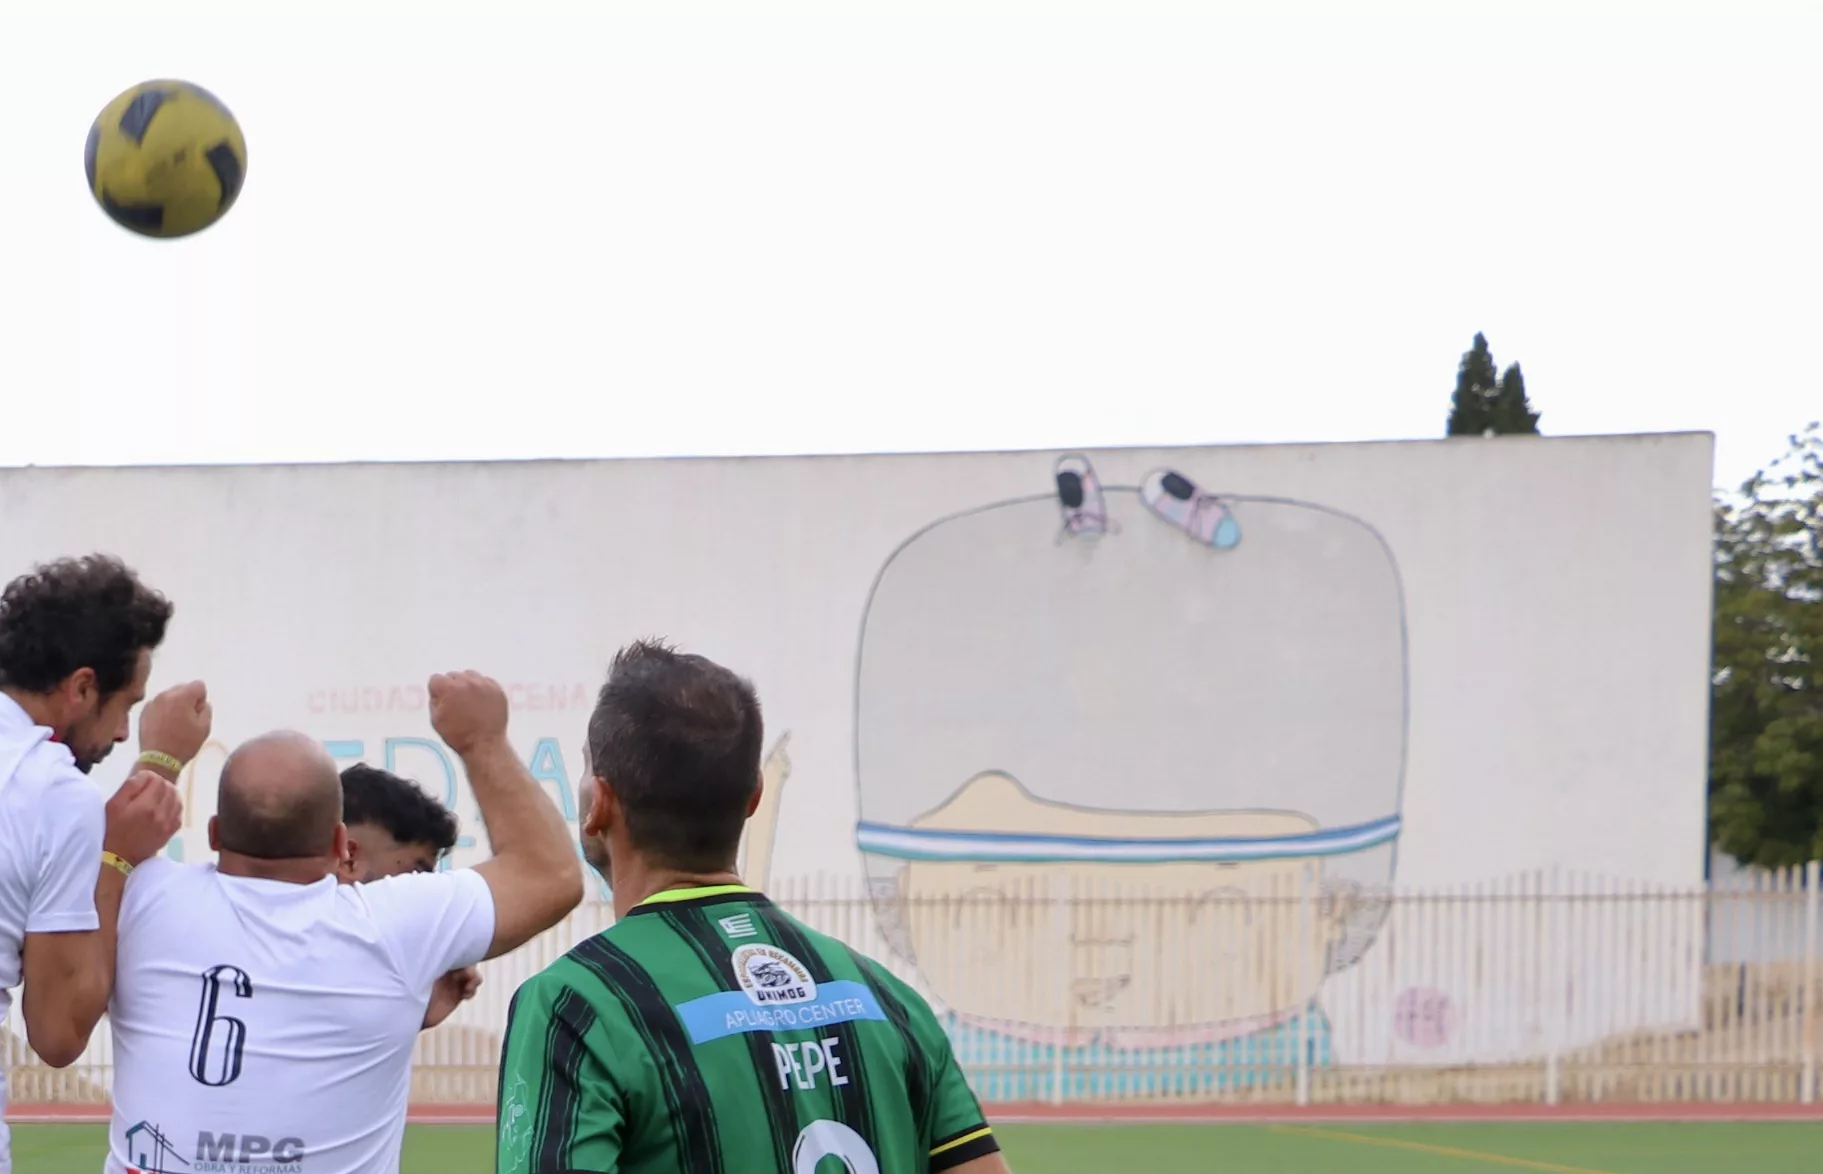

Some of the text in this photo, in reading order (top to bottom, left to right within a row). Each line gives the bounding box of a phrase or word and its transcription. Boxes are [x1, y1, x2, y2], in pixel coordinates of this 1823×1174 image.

[189, 964, 253, 1087] 6
[798, 998, 866, 1023] CENTER
[770, 1036, 850, 1091] PEPE
[195, 1130, 307, 1163] MPG
[194, 1162, 303, 1174] OBRA Y REFORMAS
